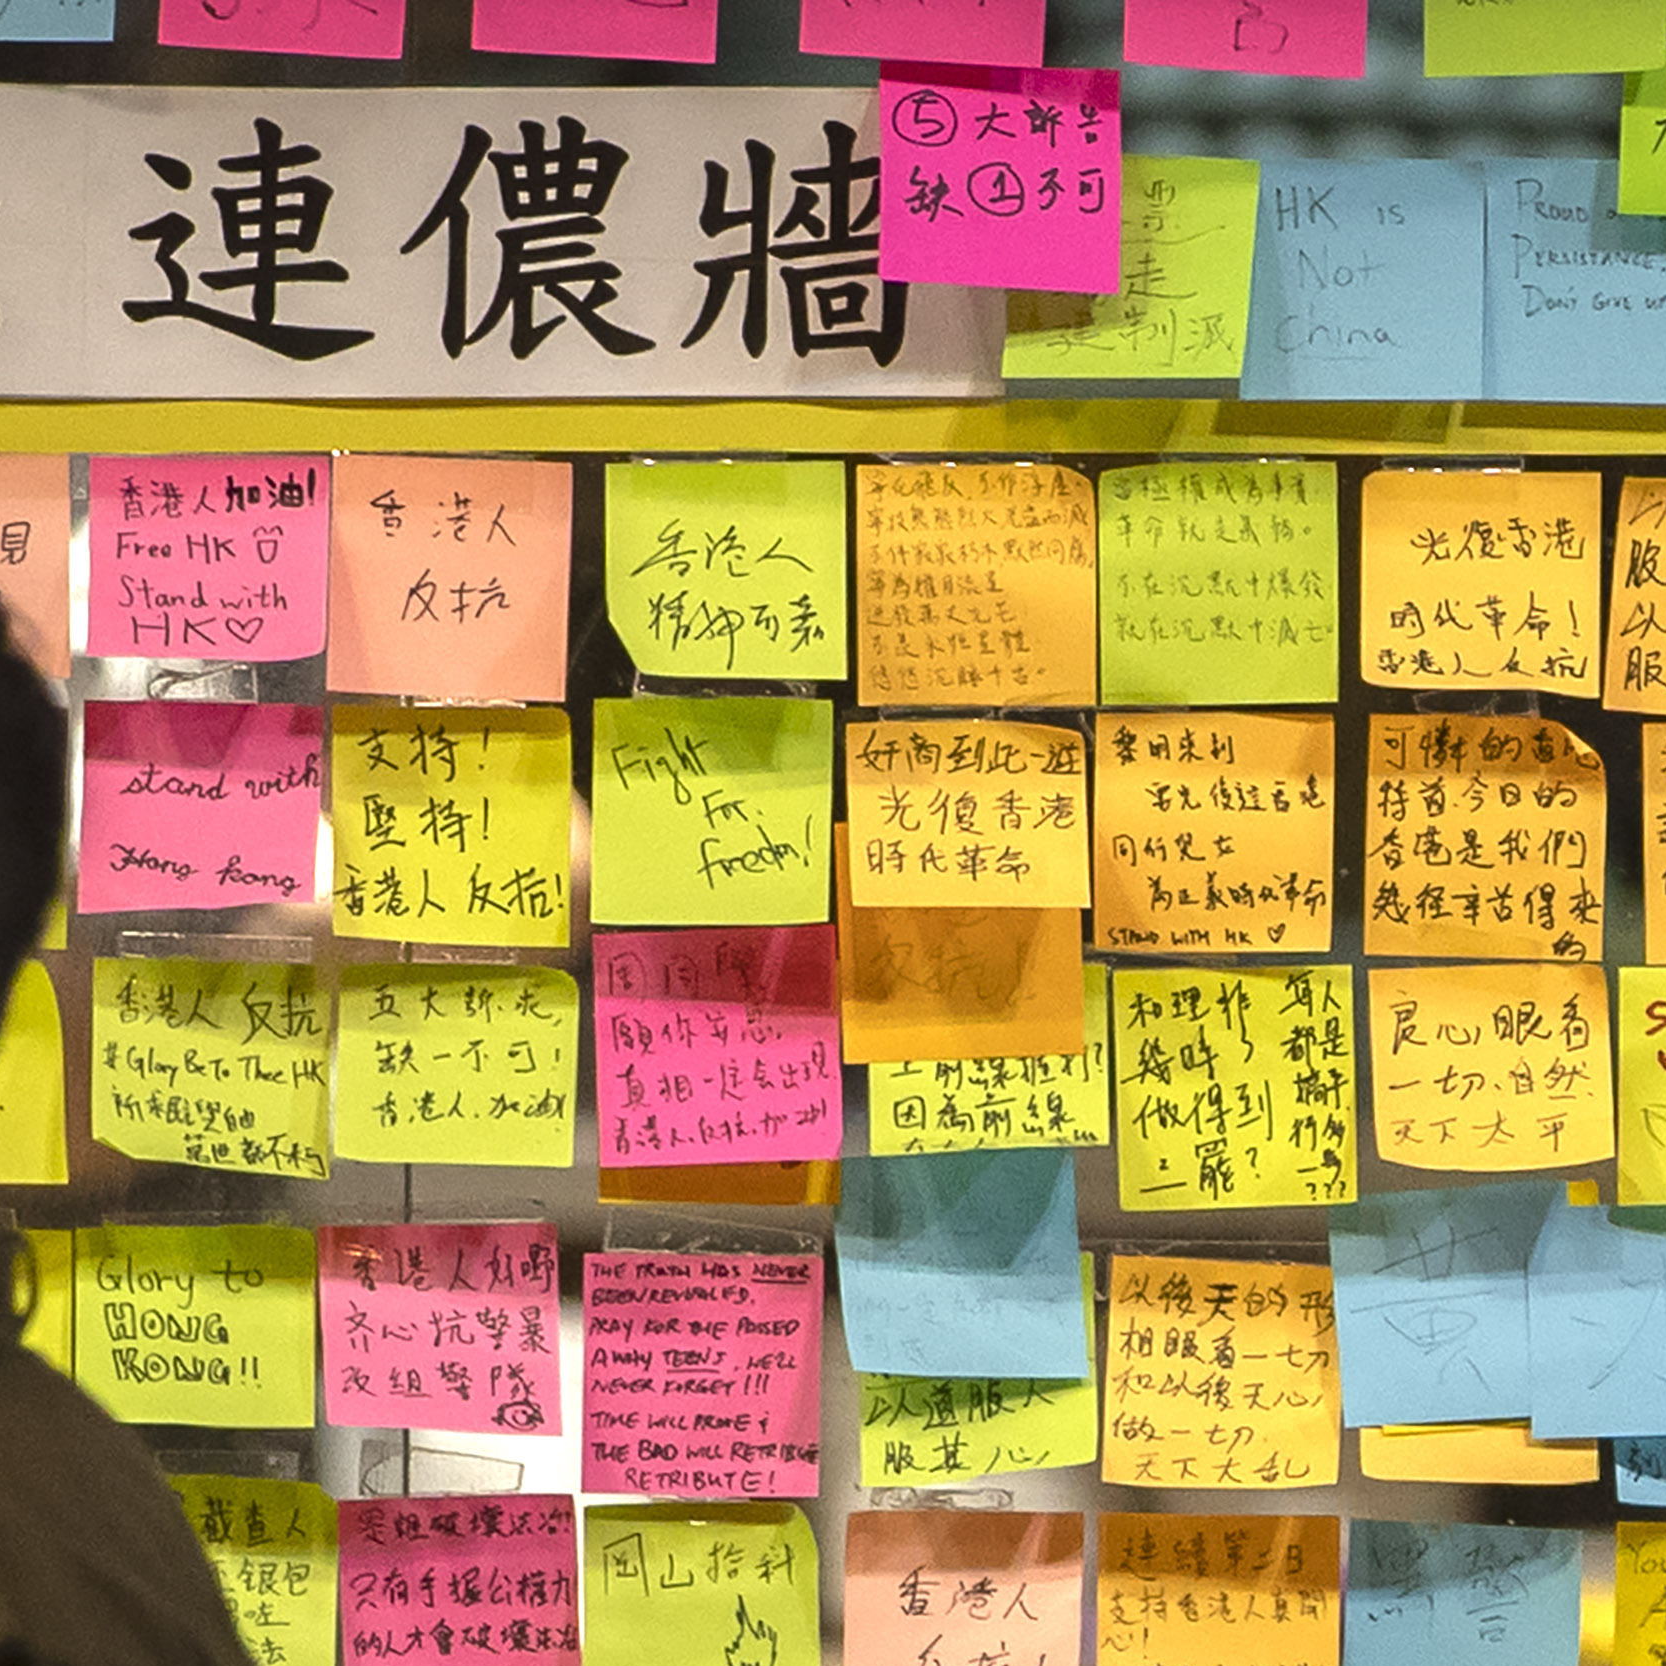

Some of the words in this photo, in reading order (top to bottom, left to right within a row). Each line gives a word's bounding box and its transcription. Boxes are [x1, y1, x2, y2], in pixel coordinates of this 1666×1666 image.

[1276, 184, 1334, 231] HK
[1297, 248, 1385, 290] Not
[1277, 313, 1397, 355] China
[369, 490, 517, 546] 香港人
[115, 532, 173, 561] Free
[187, 533, 237, 562] HK
[117, 577, 206, 609] Stand
[218, 583, 289, 611] with
[133, 615, 218, 646] HK
[246, 752, 321, 797] with
[611, 729, 707, 805] Fight
[95, 1258, 200, 1312] Glory
[214, 1258, 265, 1291] to
[591, 1263, 627, 1278] THE
[752, 1263, 811, 1279] NEVER
[106, 1306, 229, 1343] HONG
[591, 1379, 654, 1395] NEVER
[590, 1412, 638, 1428] TIME
[591, 1443, 628, 1462] THE
[638, 1440, 677, 1461] BAD
[687, 1445, 722, 1459] WILL
[898, 1567, 1039, 1621] 香港人
